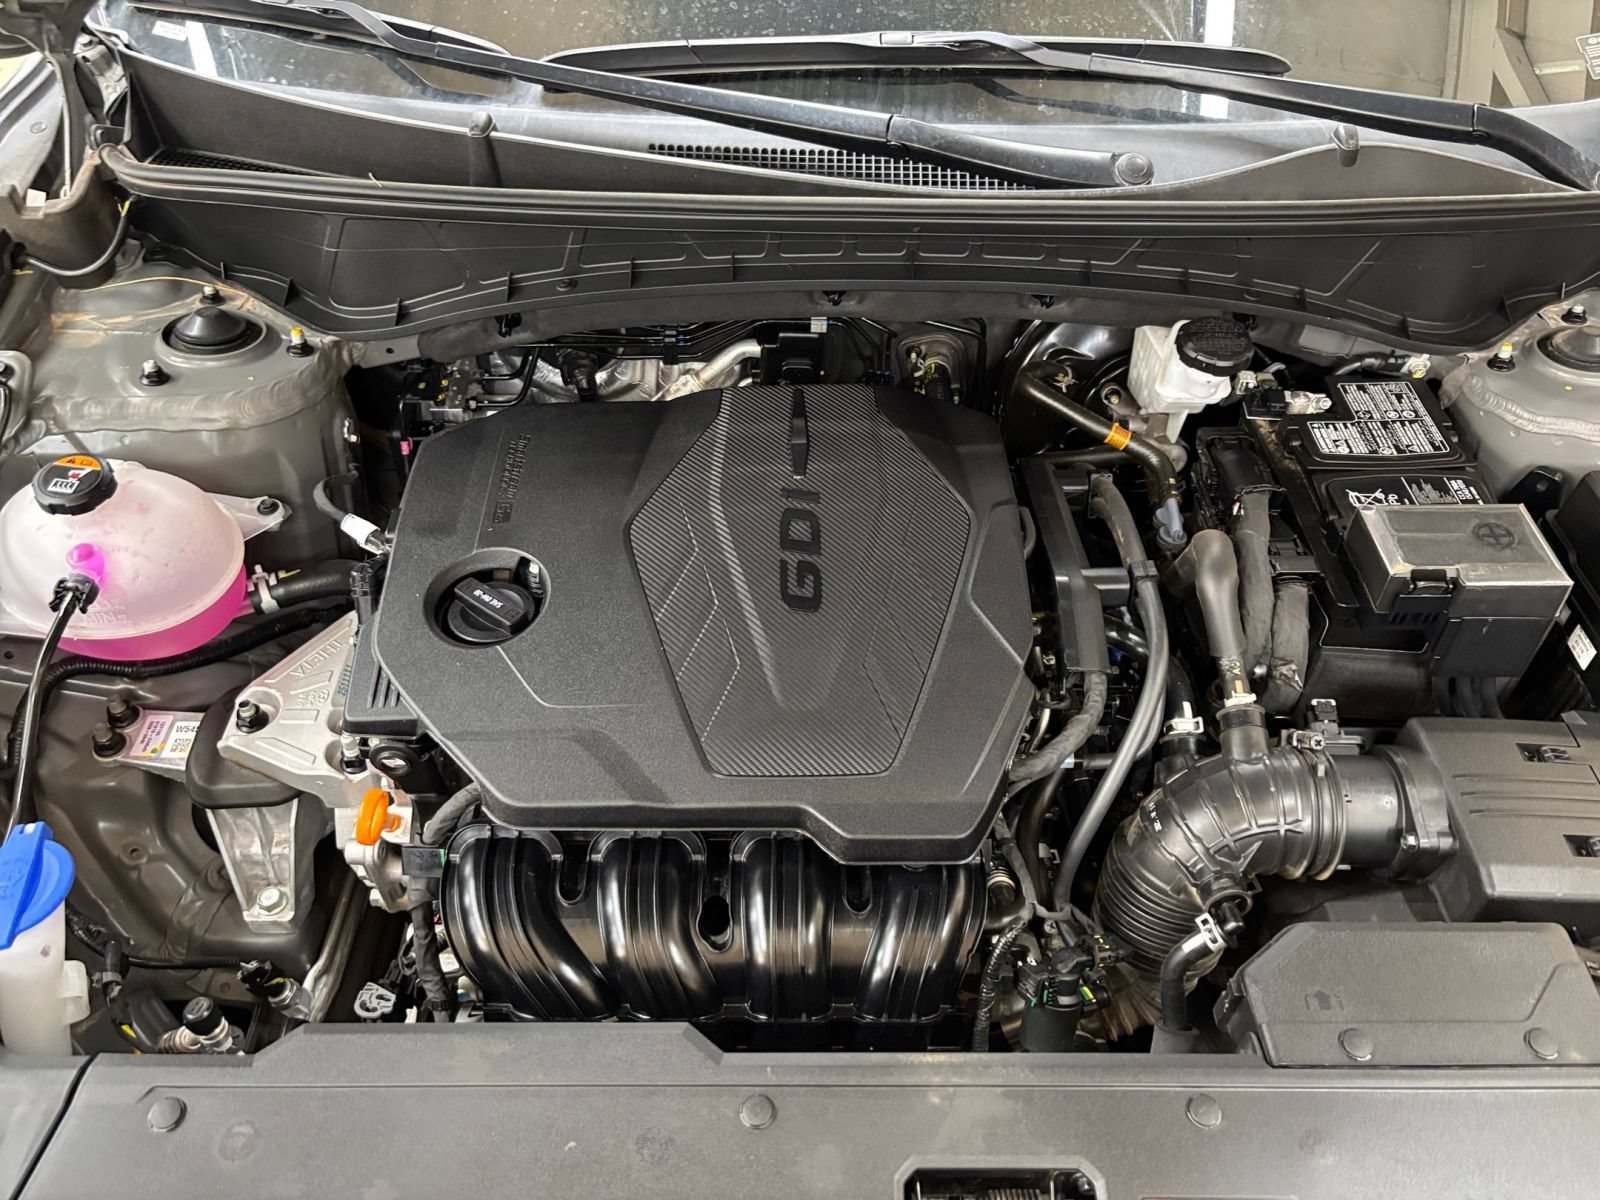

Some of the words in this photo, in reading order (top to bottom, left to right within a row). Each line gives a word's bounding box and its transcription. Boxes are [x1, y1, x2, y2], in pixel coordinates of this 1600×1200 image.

[1387, 493, 1401, 505] Pb
[780, 487, 823, 613] GDI
[289, 640, 346, 677] THETA
